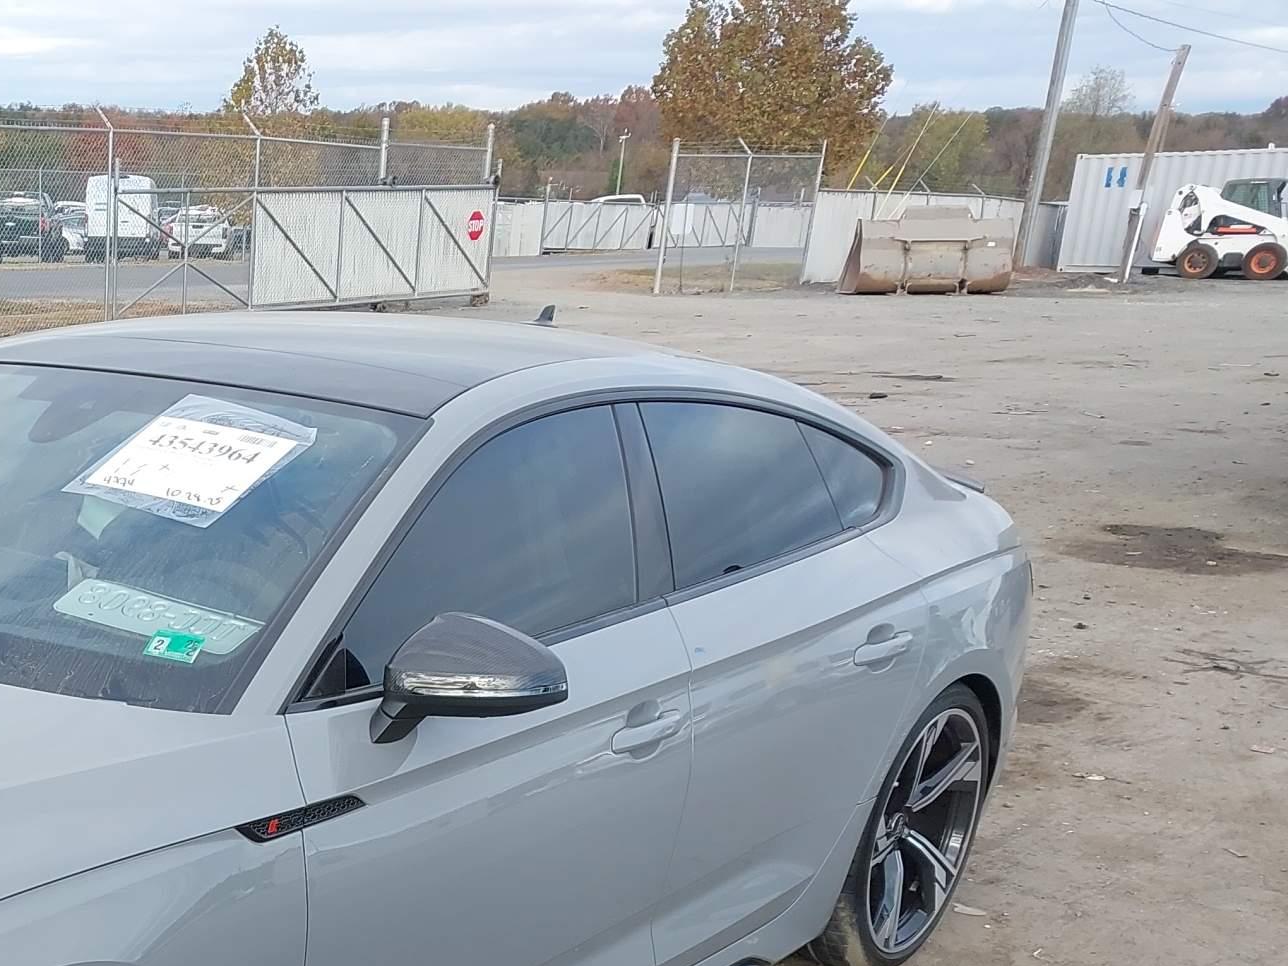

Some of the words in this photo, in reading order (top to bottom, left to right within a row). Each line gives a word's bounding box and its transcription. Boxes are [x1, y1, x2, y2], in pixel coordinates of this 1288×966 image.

[468, 219, 484, 232] STOP
[149, 434, 262, 464] 43543964
[153, 639, 165, 650] 2
